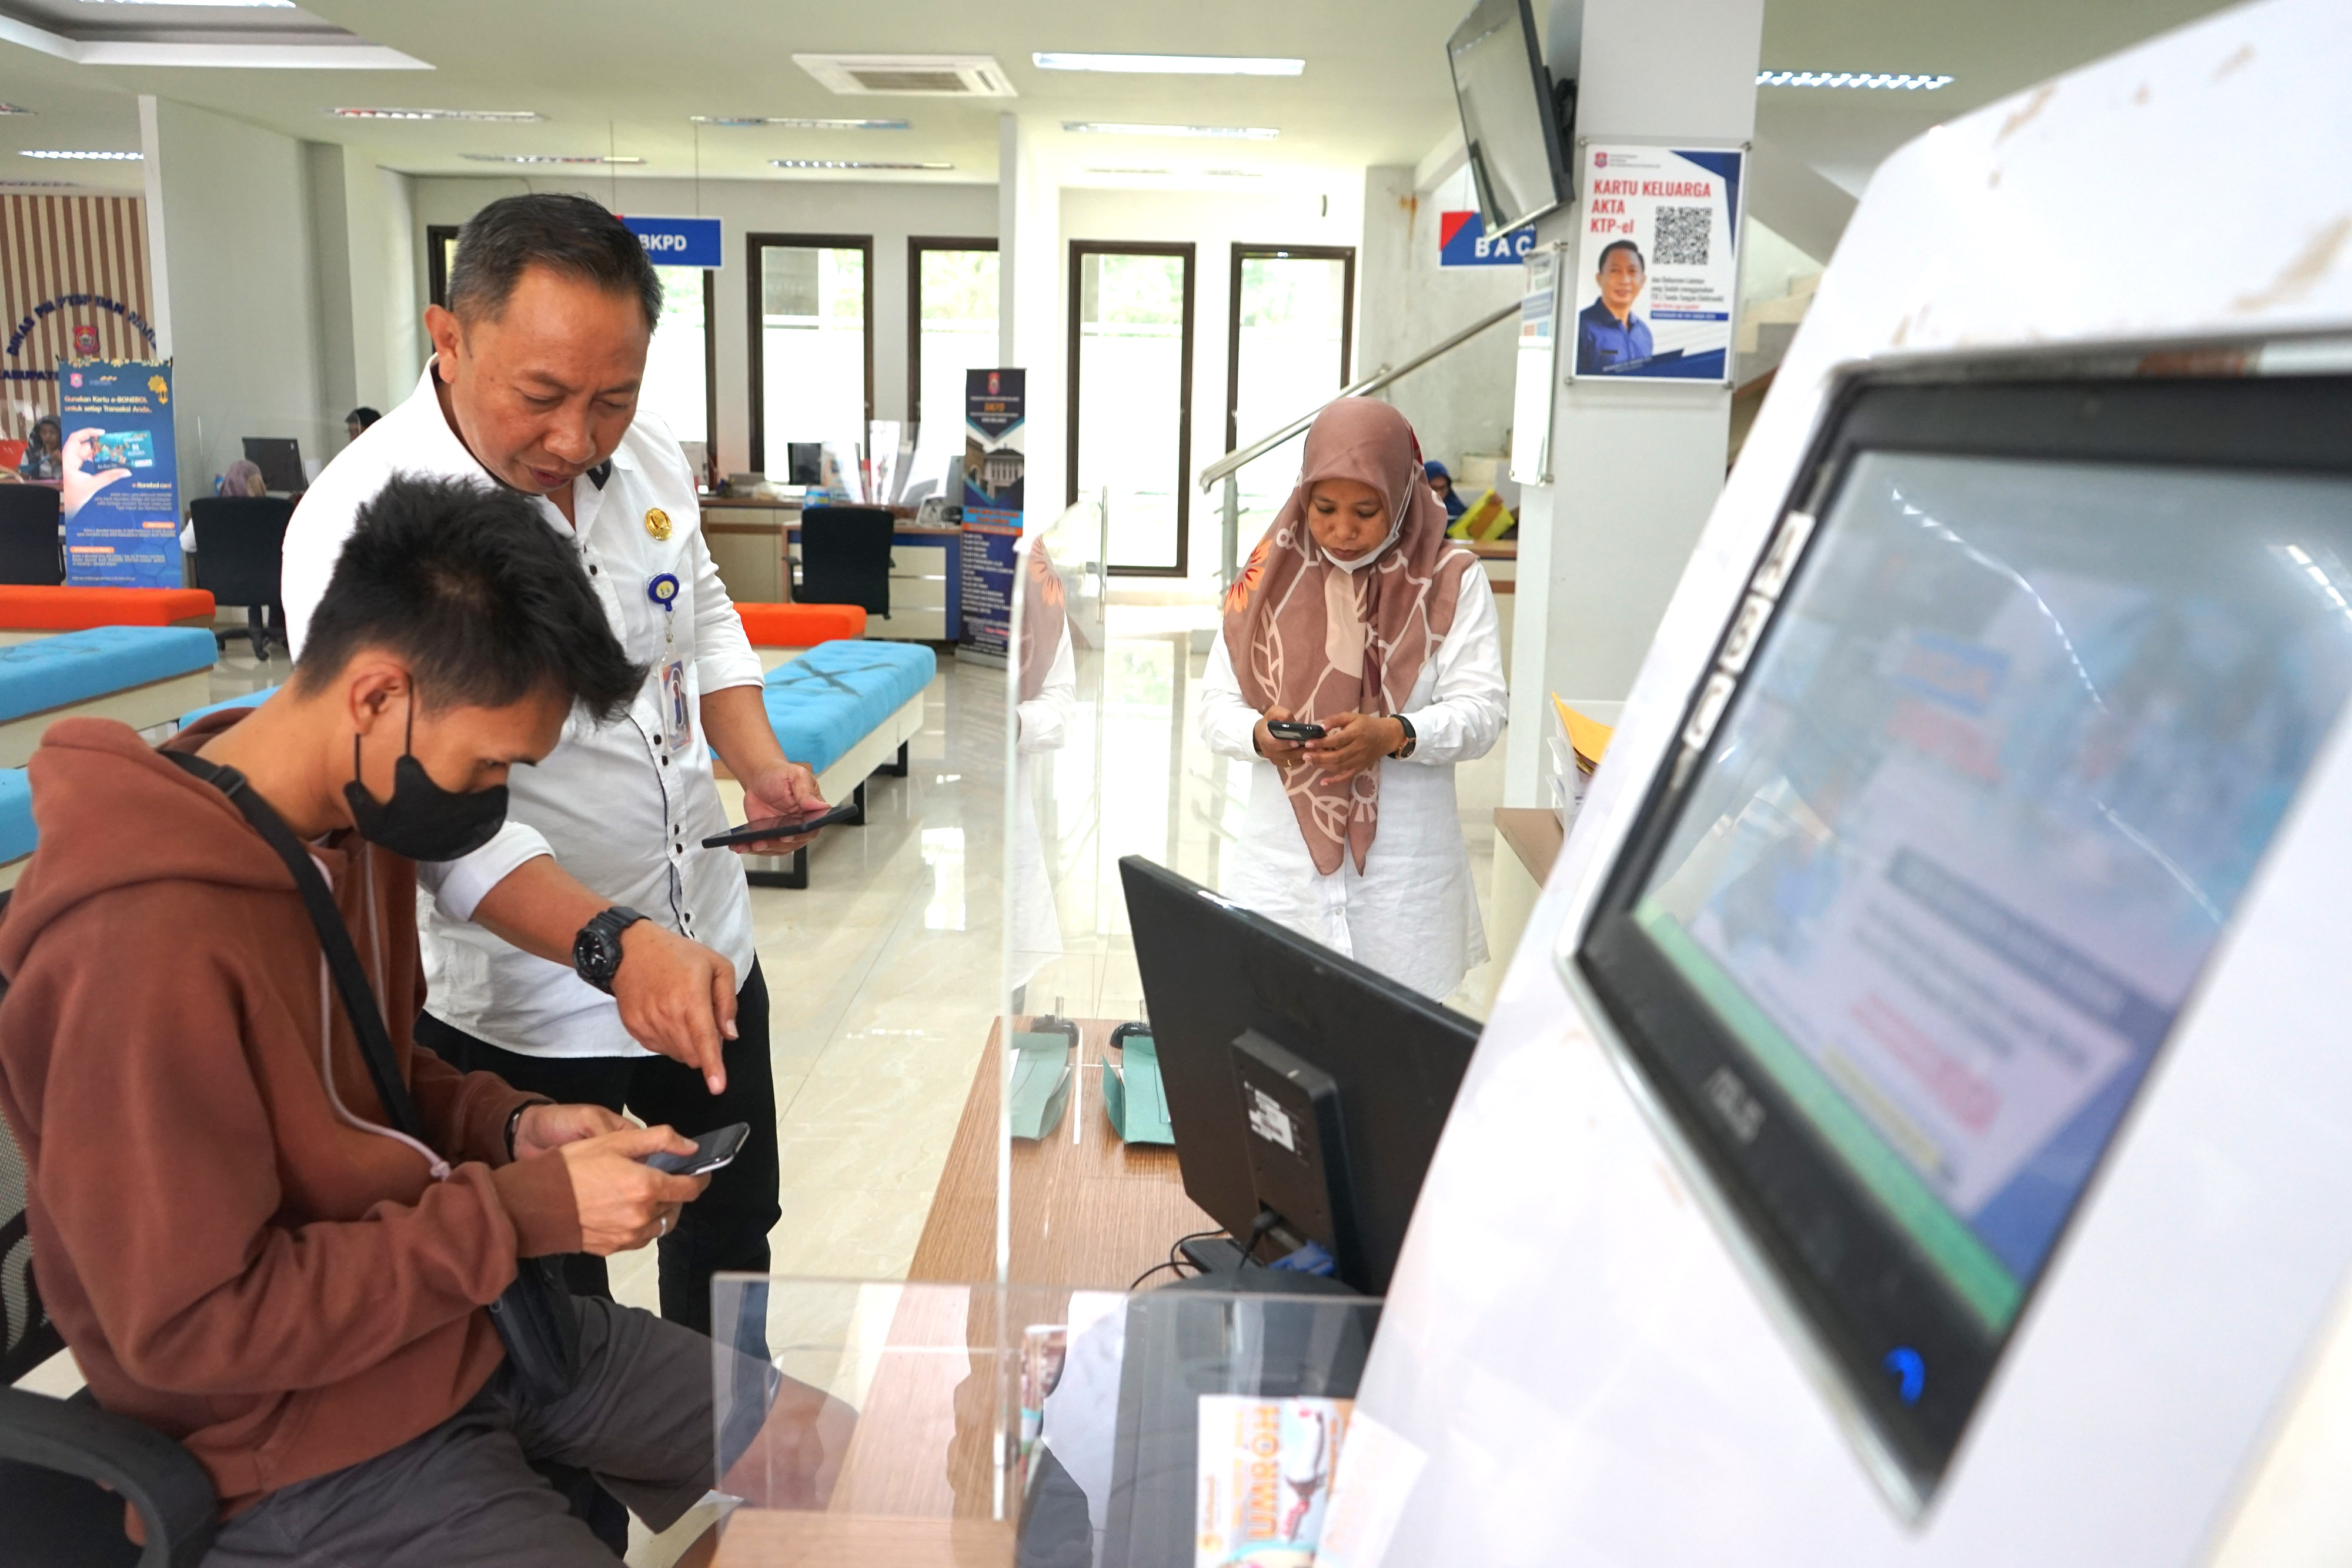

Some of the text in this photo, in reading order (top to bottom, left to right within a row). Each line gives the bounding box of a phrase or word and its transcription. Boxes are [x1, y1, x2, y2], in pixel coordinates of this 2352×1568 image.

[1594, 179, 1711, 197] KARTU KELUARGA
[1591, 199, 1625, 214] AKTA
[1591, 218, 1634, 233] KTP-el
[639, 234, 687, 251] BKPD
[6, 316, 35, 356] DINAS
[95, 295, 125, 315] DAN
[64, 395, 91, 403] Gunakan
[93, 395, 109, 403] Kartu
[84, 405, 102, 413] setiap
[103, 404, 131, 413] Transaksi
[1248, 1406, 1279, 1539] UMROH
